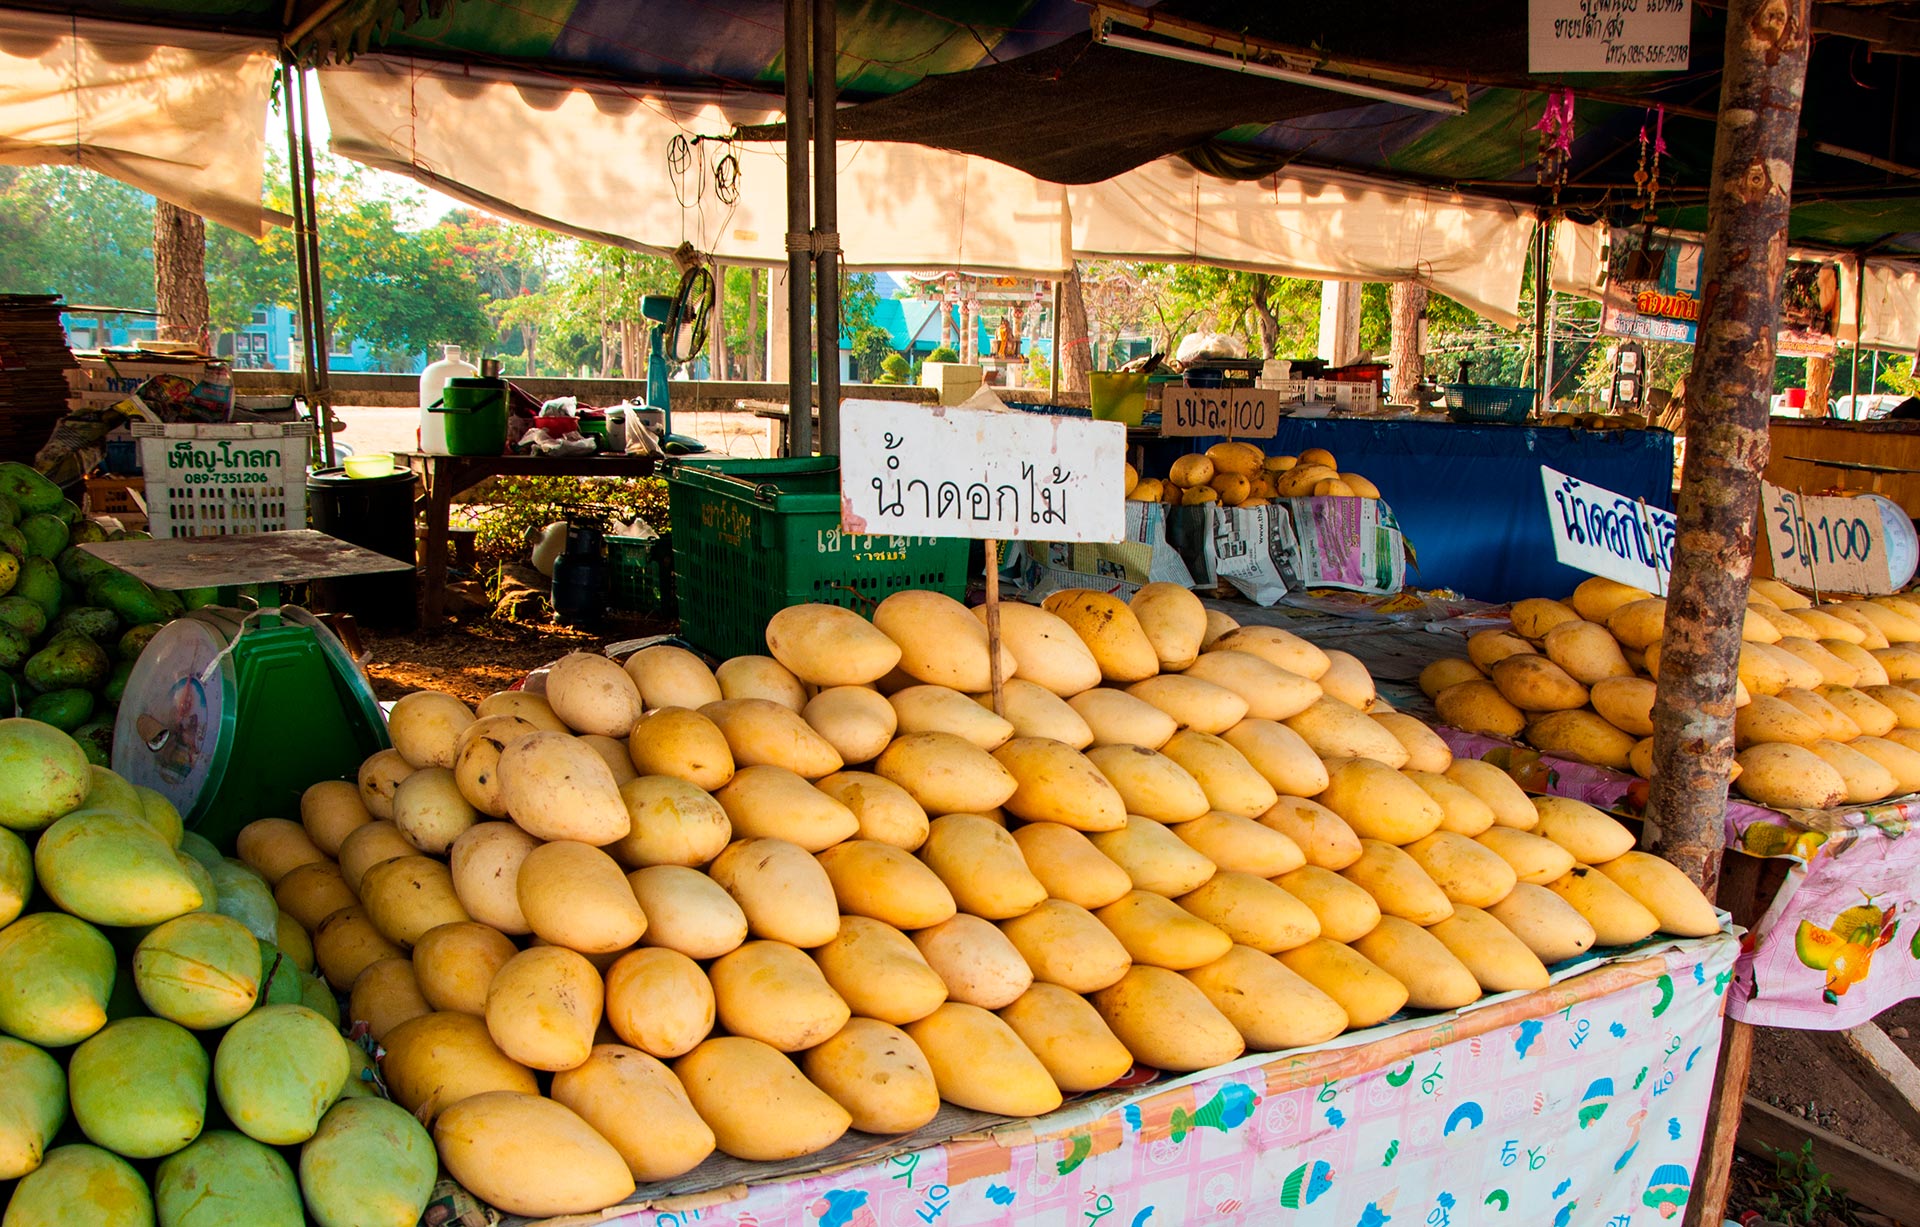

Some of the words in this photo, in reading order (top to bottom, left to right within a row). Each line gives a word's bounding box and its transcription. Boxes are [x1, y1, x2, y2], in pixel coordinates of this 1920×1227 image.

[1234, 400, 1265, 430] 100
[167, 441, 281, 473] เพ็ญ-โกลก
[184, 473, 268, 484] 089-7351206
[871, 432, 1071, 525] น้ำดอกไม้
[1554, 476, 1677, 573] น้ำดอกไม้
[1818, 515, 1872, 563] 100
